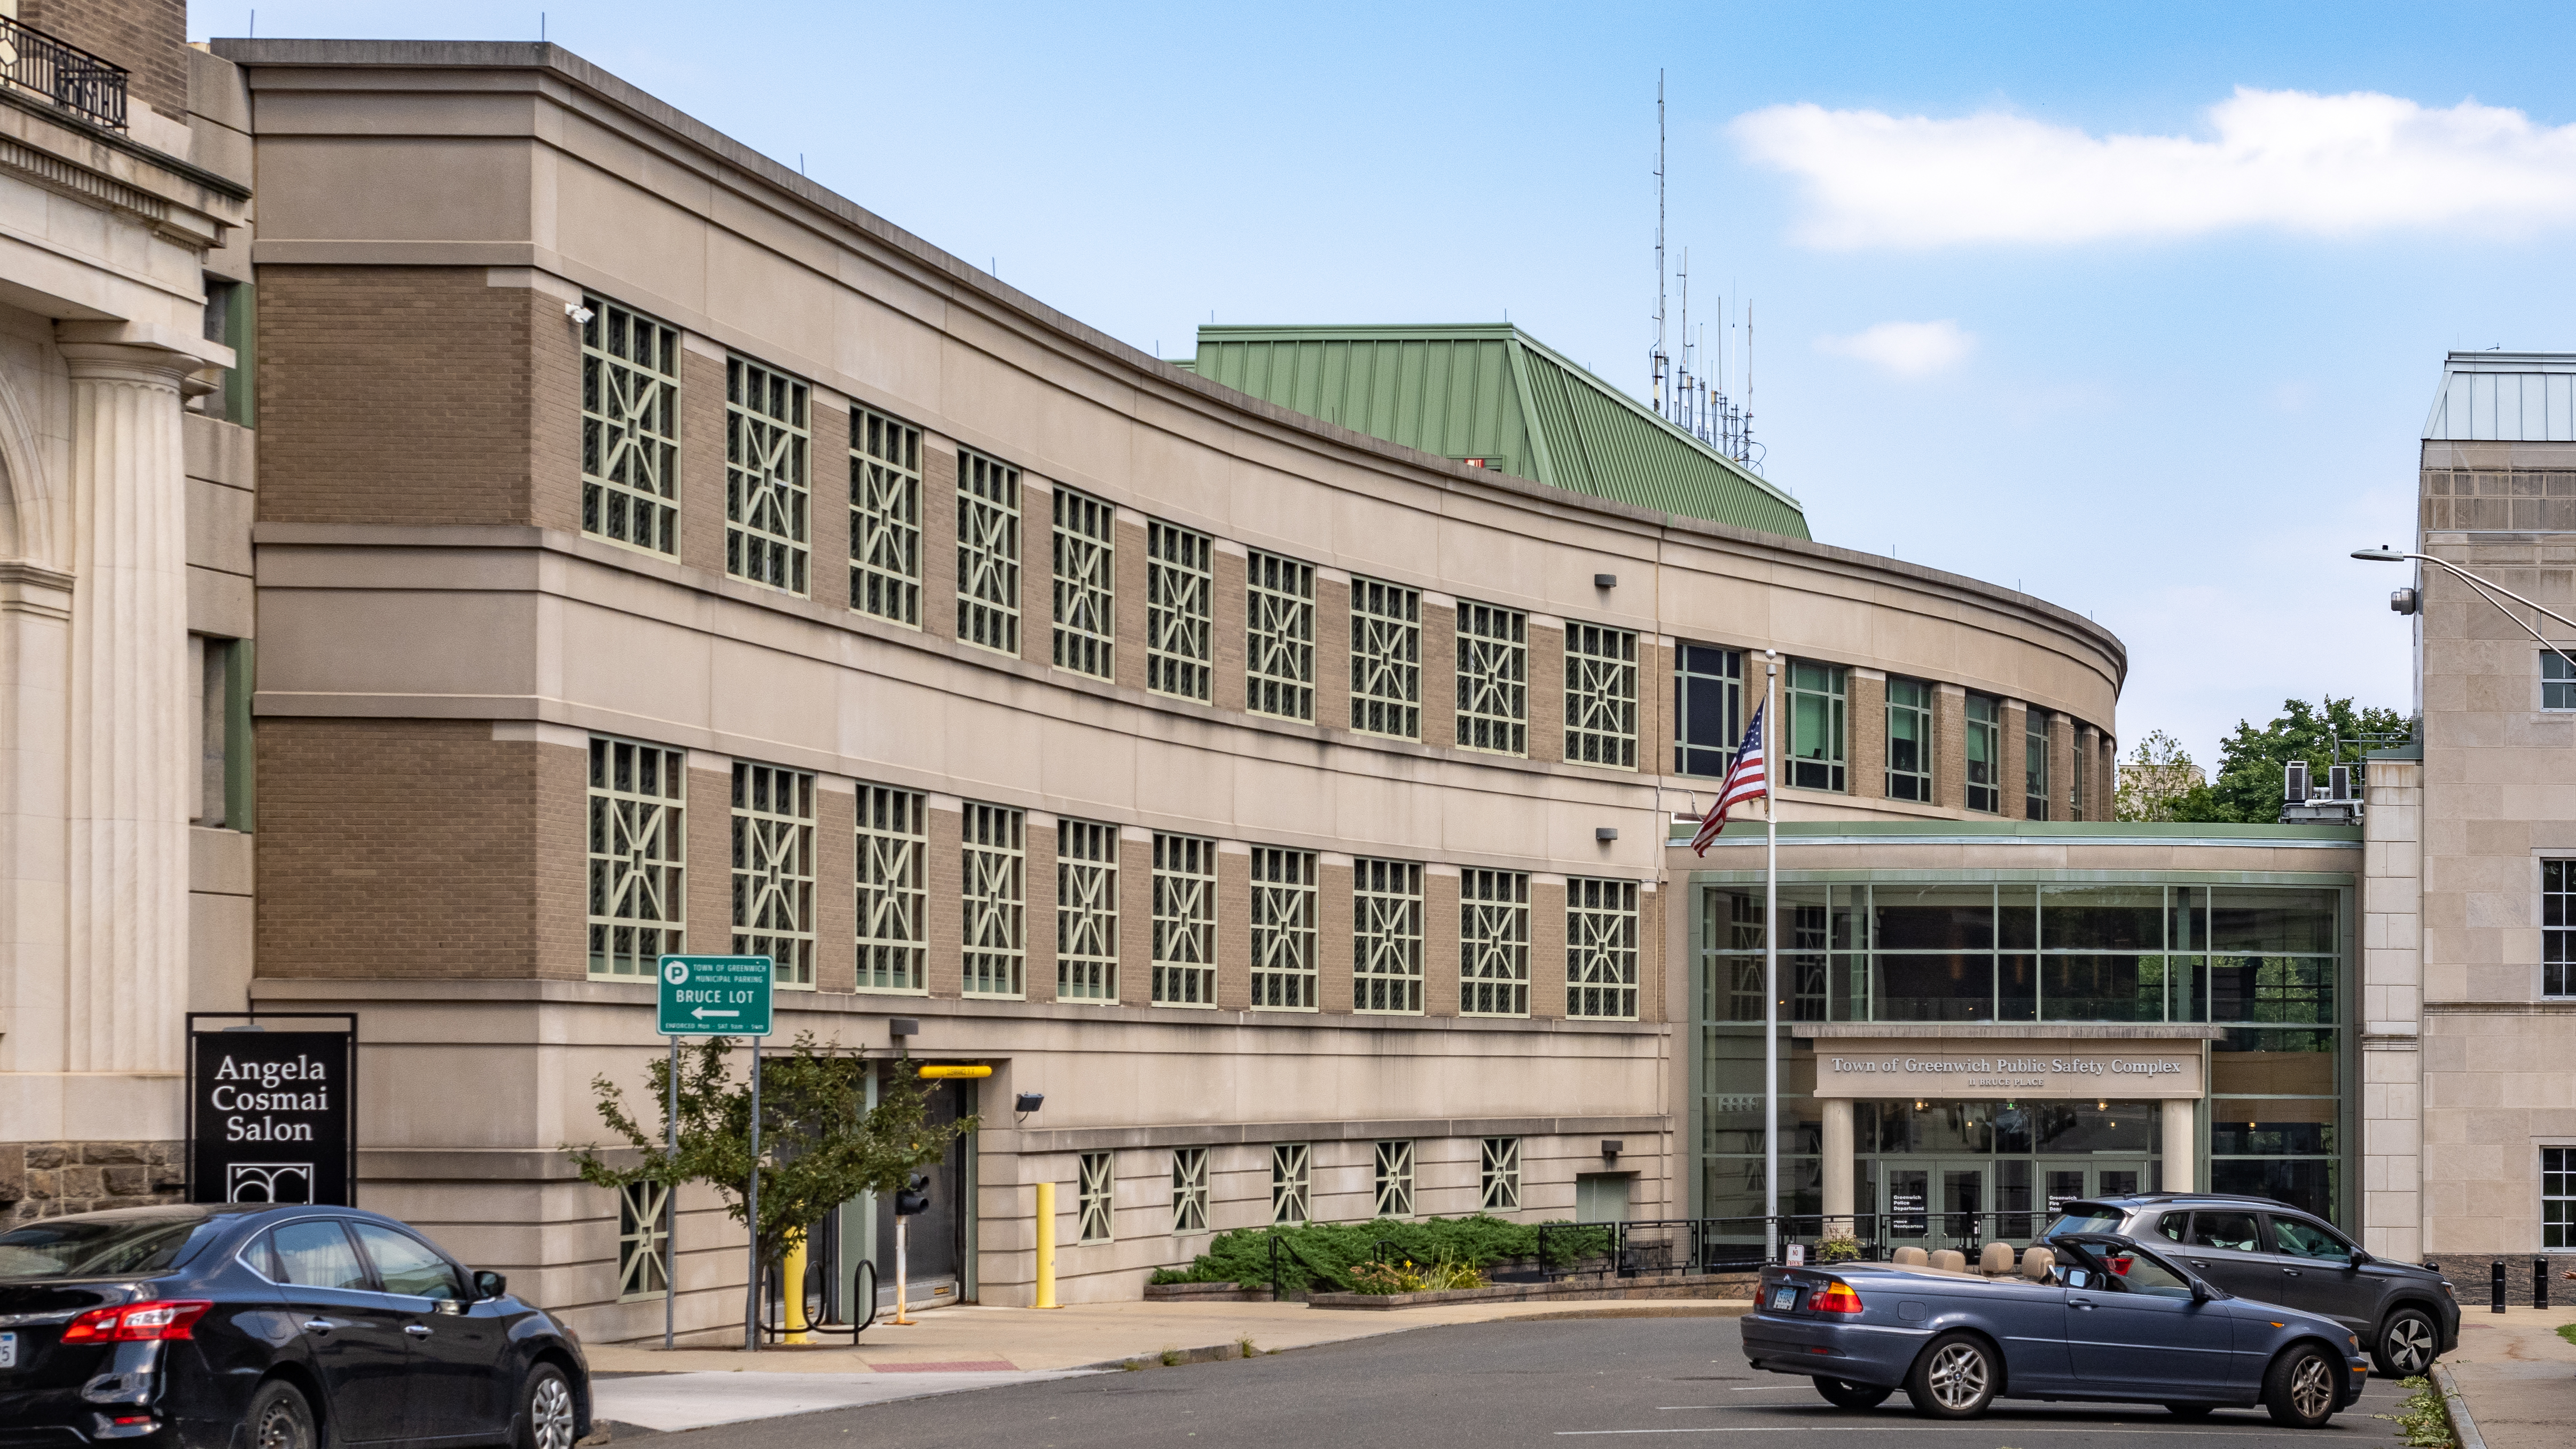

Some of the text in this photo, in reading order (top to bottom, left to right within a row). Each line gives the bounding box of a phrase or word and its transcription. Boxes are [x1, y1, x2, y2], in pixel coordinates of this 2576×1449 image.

[671, 967, 683, 980] P
[676, 990, 754, 1004] BRUCE LOT
[215, 1055, 326, 1088] Angela
[1832, 1058, 2181, 1077] Town of Greenwich Public Safety Complex
[2014, 1078, 2044, 1086] PLACE
[212, 1086, 328, 1110] Cosmai
[226, 1116, 314, 1141] Salon
